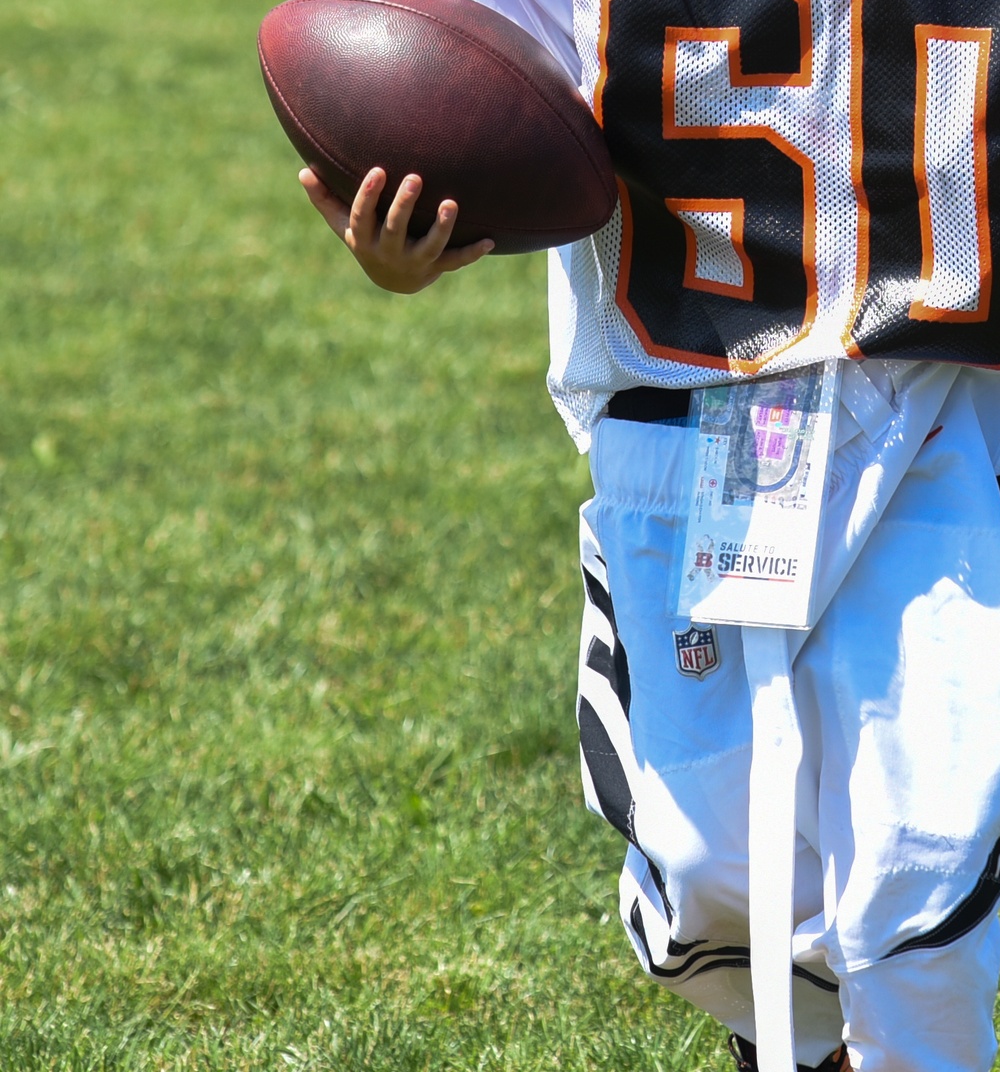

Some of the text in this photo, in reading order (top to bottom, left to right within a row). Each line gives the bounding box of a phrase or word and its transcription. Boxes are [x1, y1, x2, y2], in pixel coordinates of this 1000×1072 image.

[720, 542, 776, 555] SALUTE TO
[717, 552, 798, 577] SERVICE
[681, 646, 714, 670] NFL
